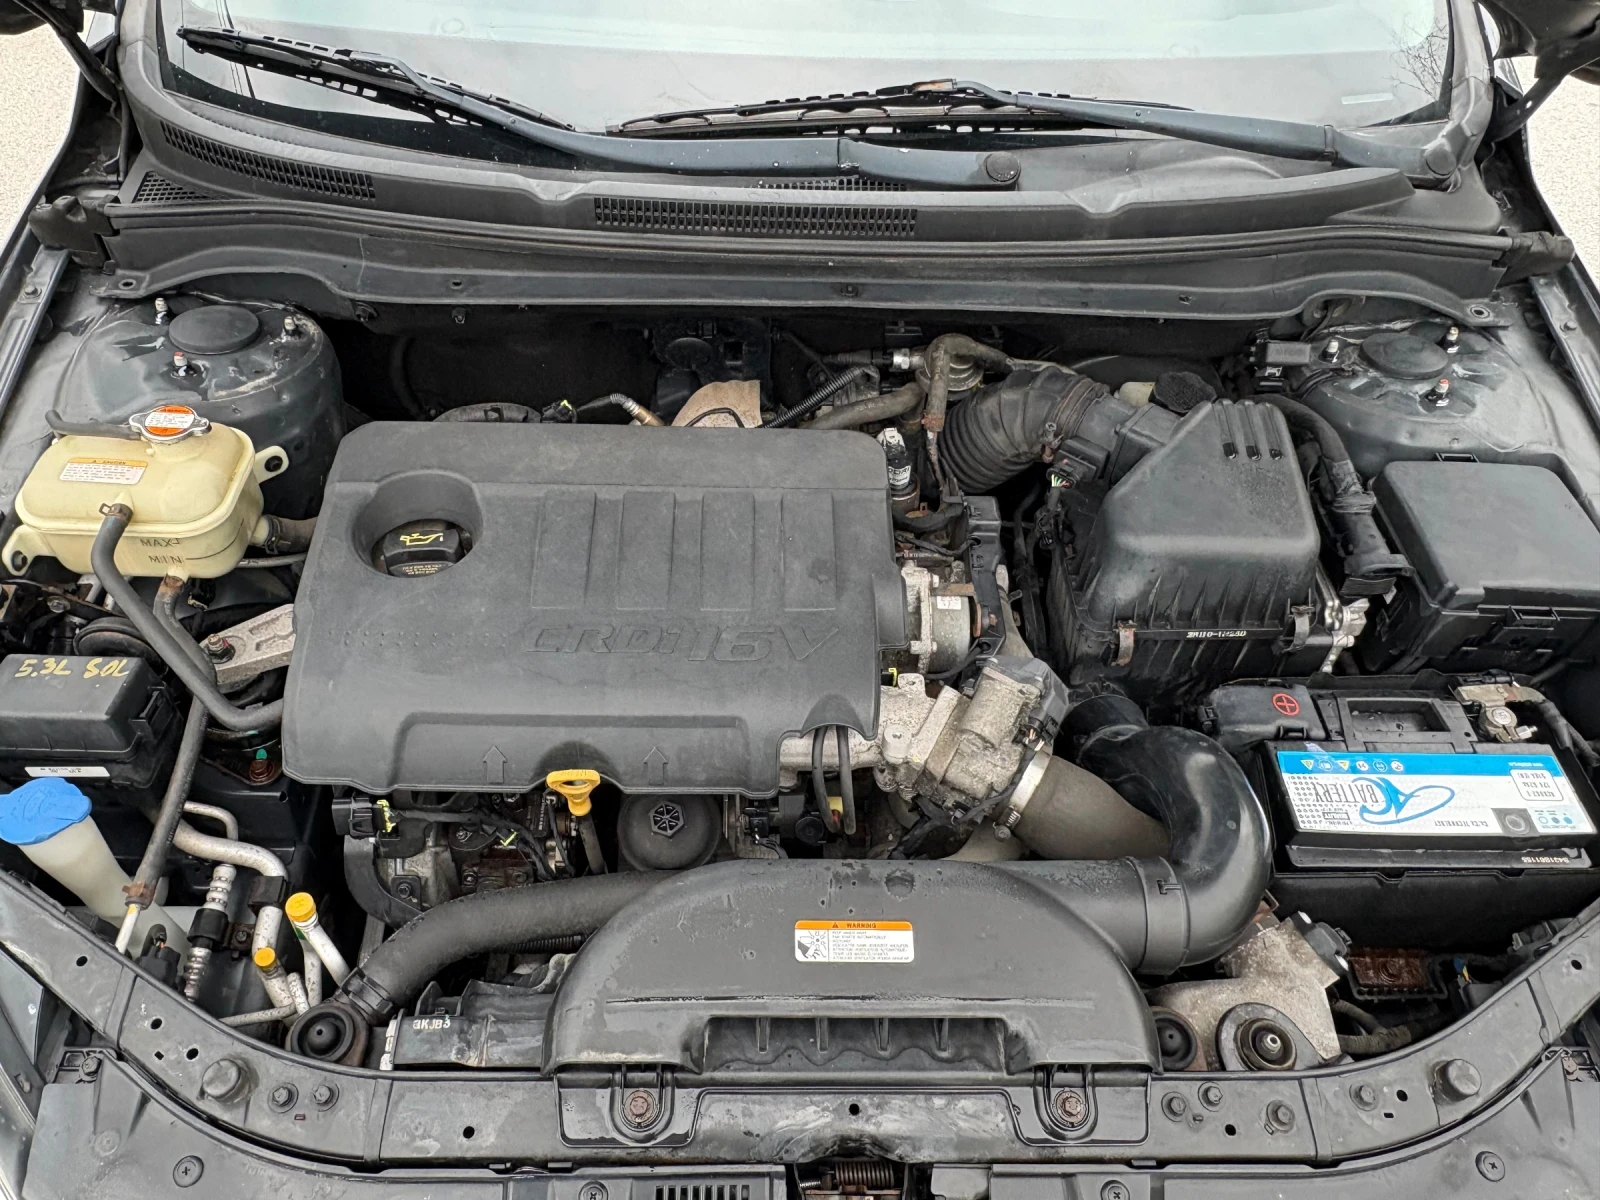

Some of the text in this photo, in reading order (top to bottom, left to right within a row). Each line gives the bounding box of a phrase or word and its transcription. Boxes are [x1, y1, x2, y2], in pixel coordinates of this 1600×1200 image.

[140, 538, 175, 547] MAX
[148, 555, 183, 564] MIN
[14, 657, 72, 678] 5.3L
[1311, 782, 1379, 804] BATTERY
